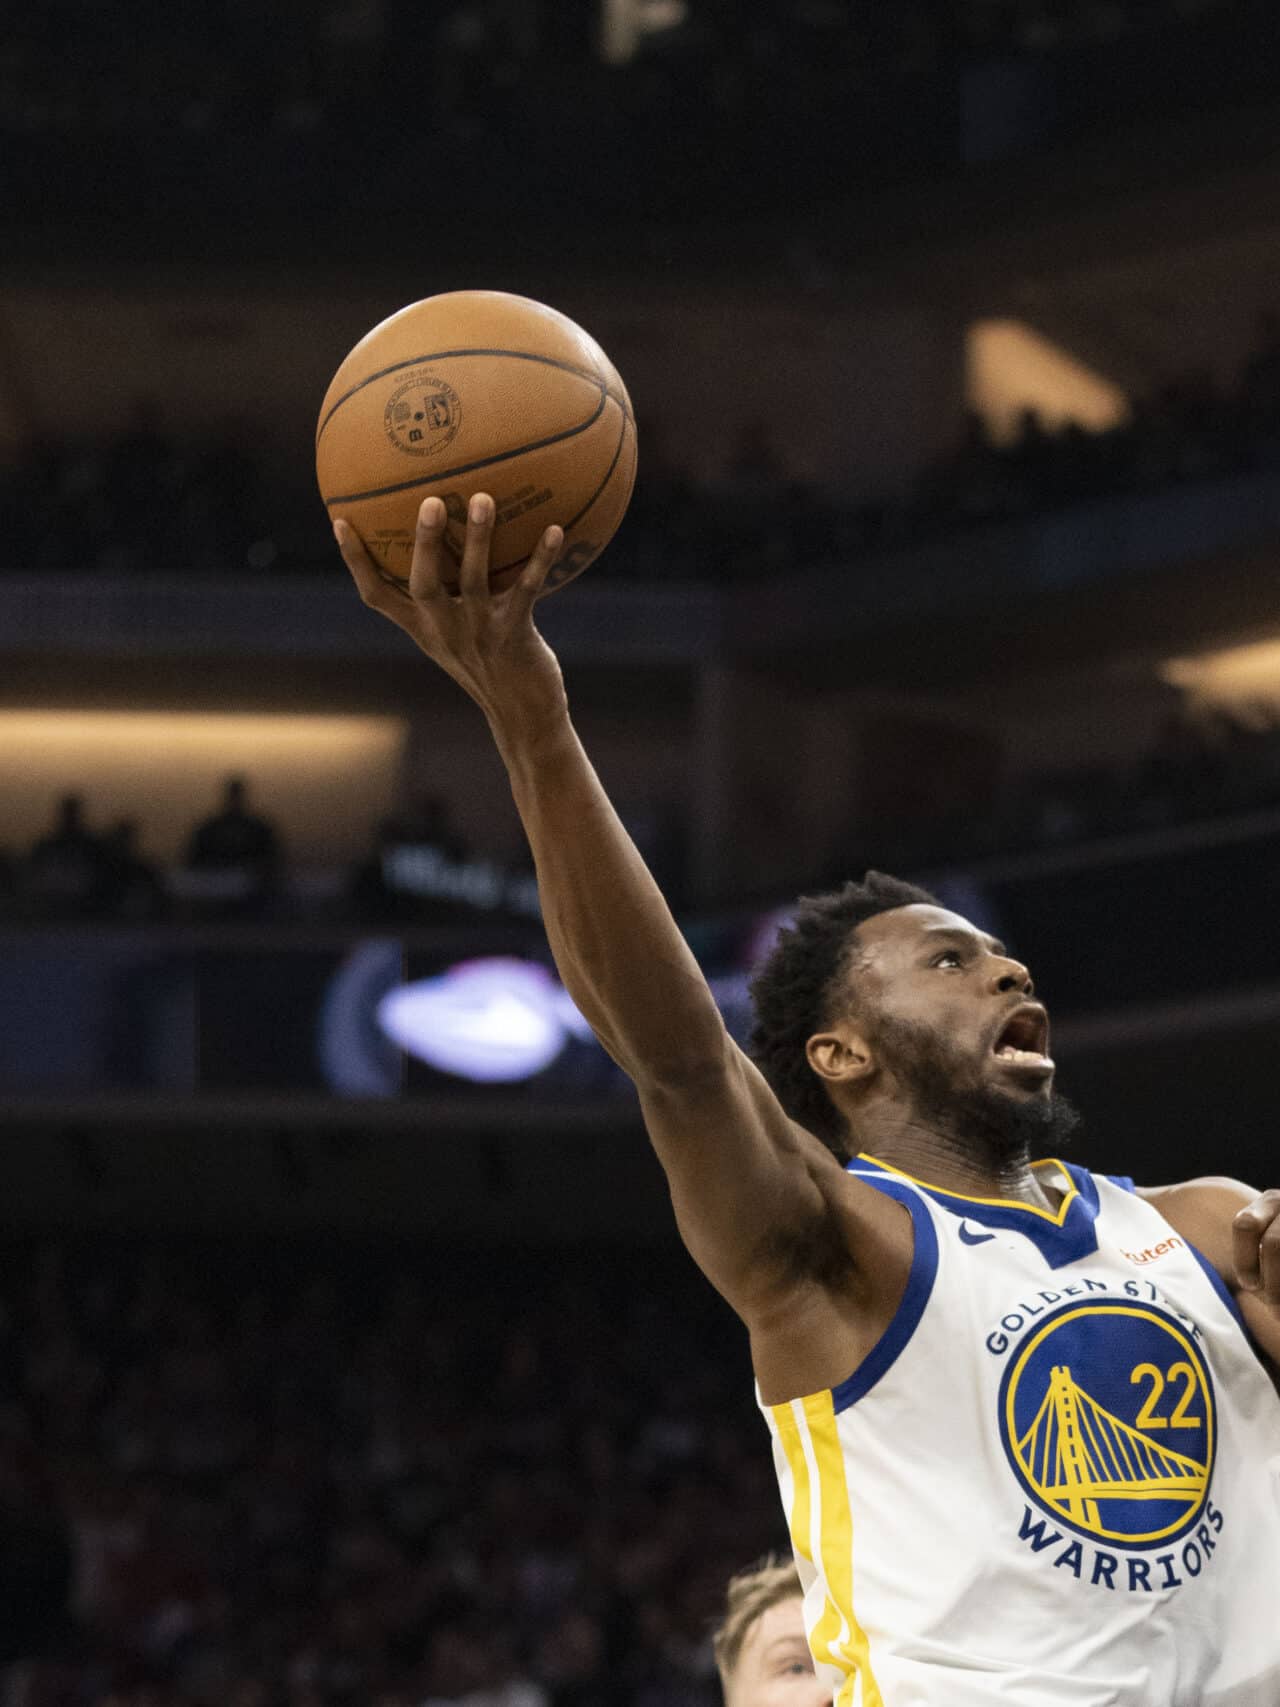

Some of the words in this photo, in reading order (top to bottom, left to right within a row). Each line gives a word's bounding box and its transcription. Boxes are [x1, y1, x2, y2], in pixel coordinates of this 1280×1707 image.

[985, 1278, 1108, 1356] GOLDEN
[1130, 1362, 1201, 1429] 22
[1017, 1500, 1225, 1592] WARRIORS
